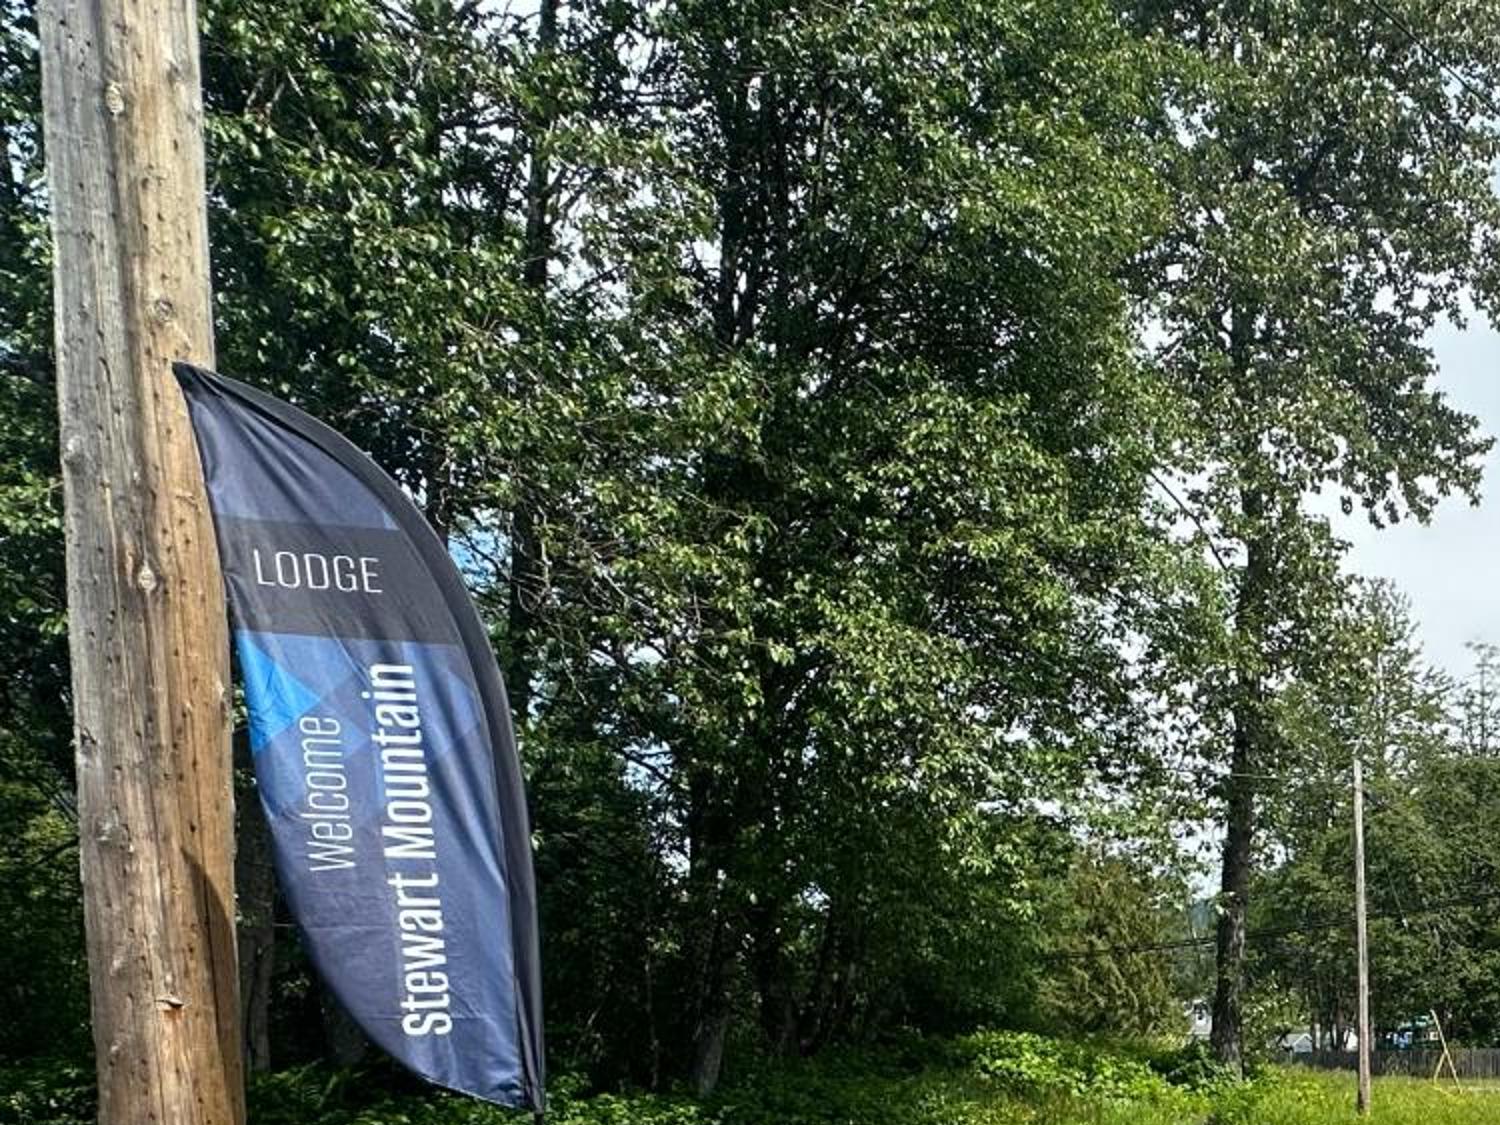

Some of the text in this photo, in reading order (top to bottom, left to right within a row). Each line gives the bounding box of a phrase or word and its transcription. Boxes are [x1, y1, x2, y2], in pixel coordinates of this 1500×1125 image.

[253, 549, 384, 595] LODGE
[300, 715, 356, 872] Welcome
[361, 662, 453, 1038] Stewart Mountain
